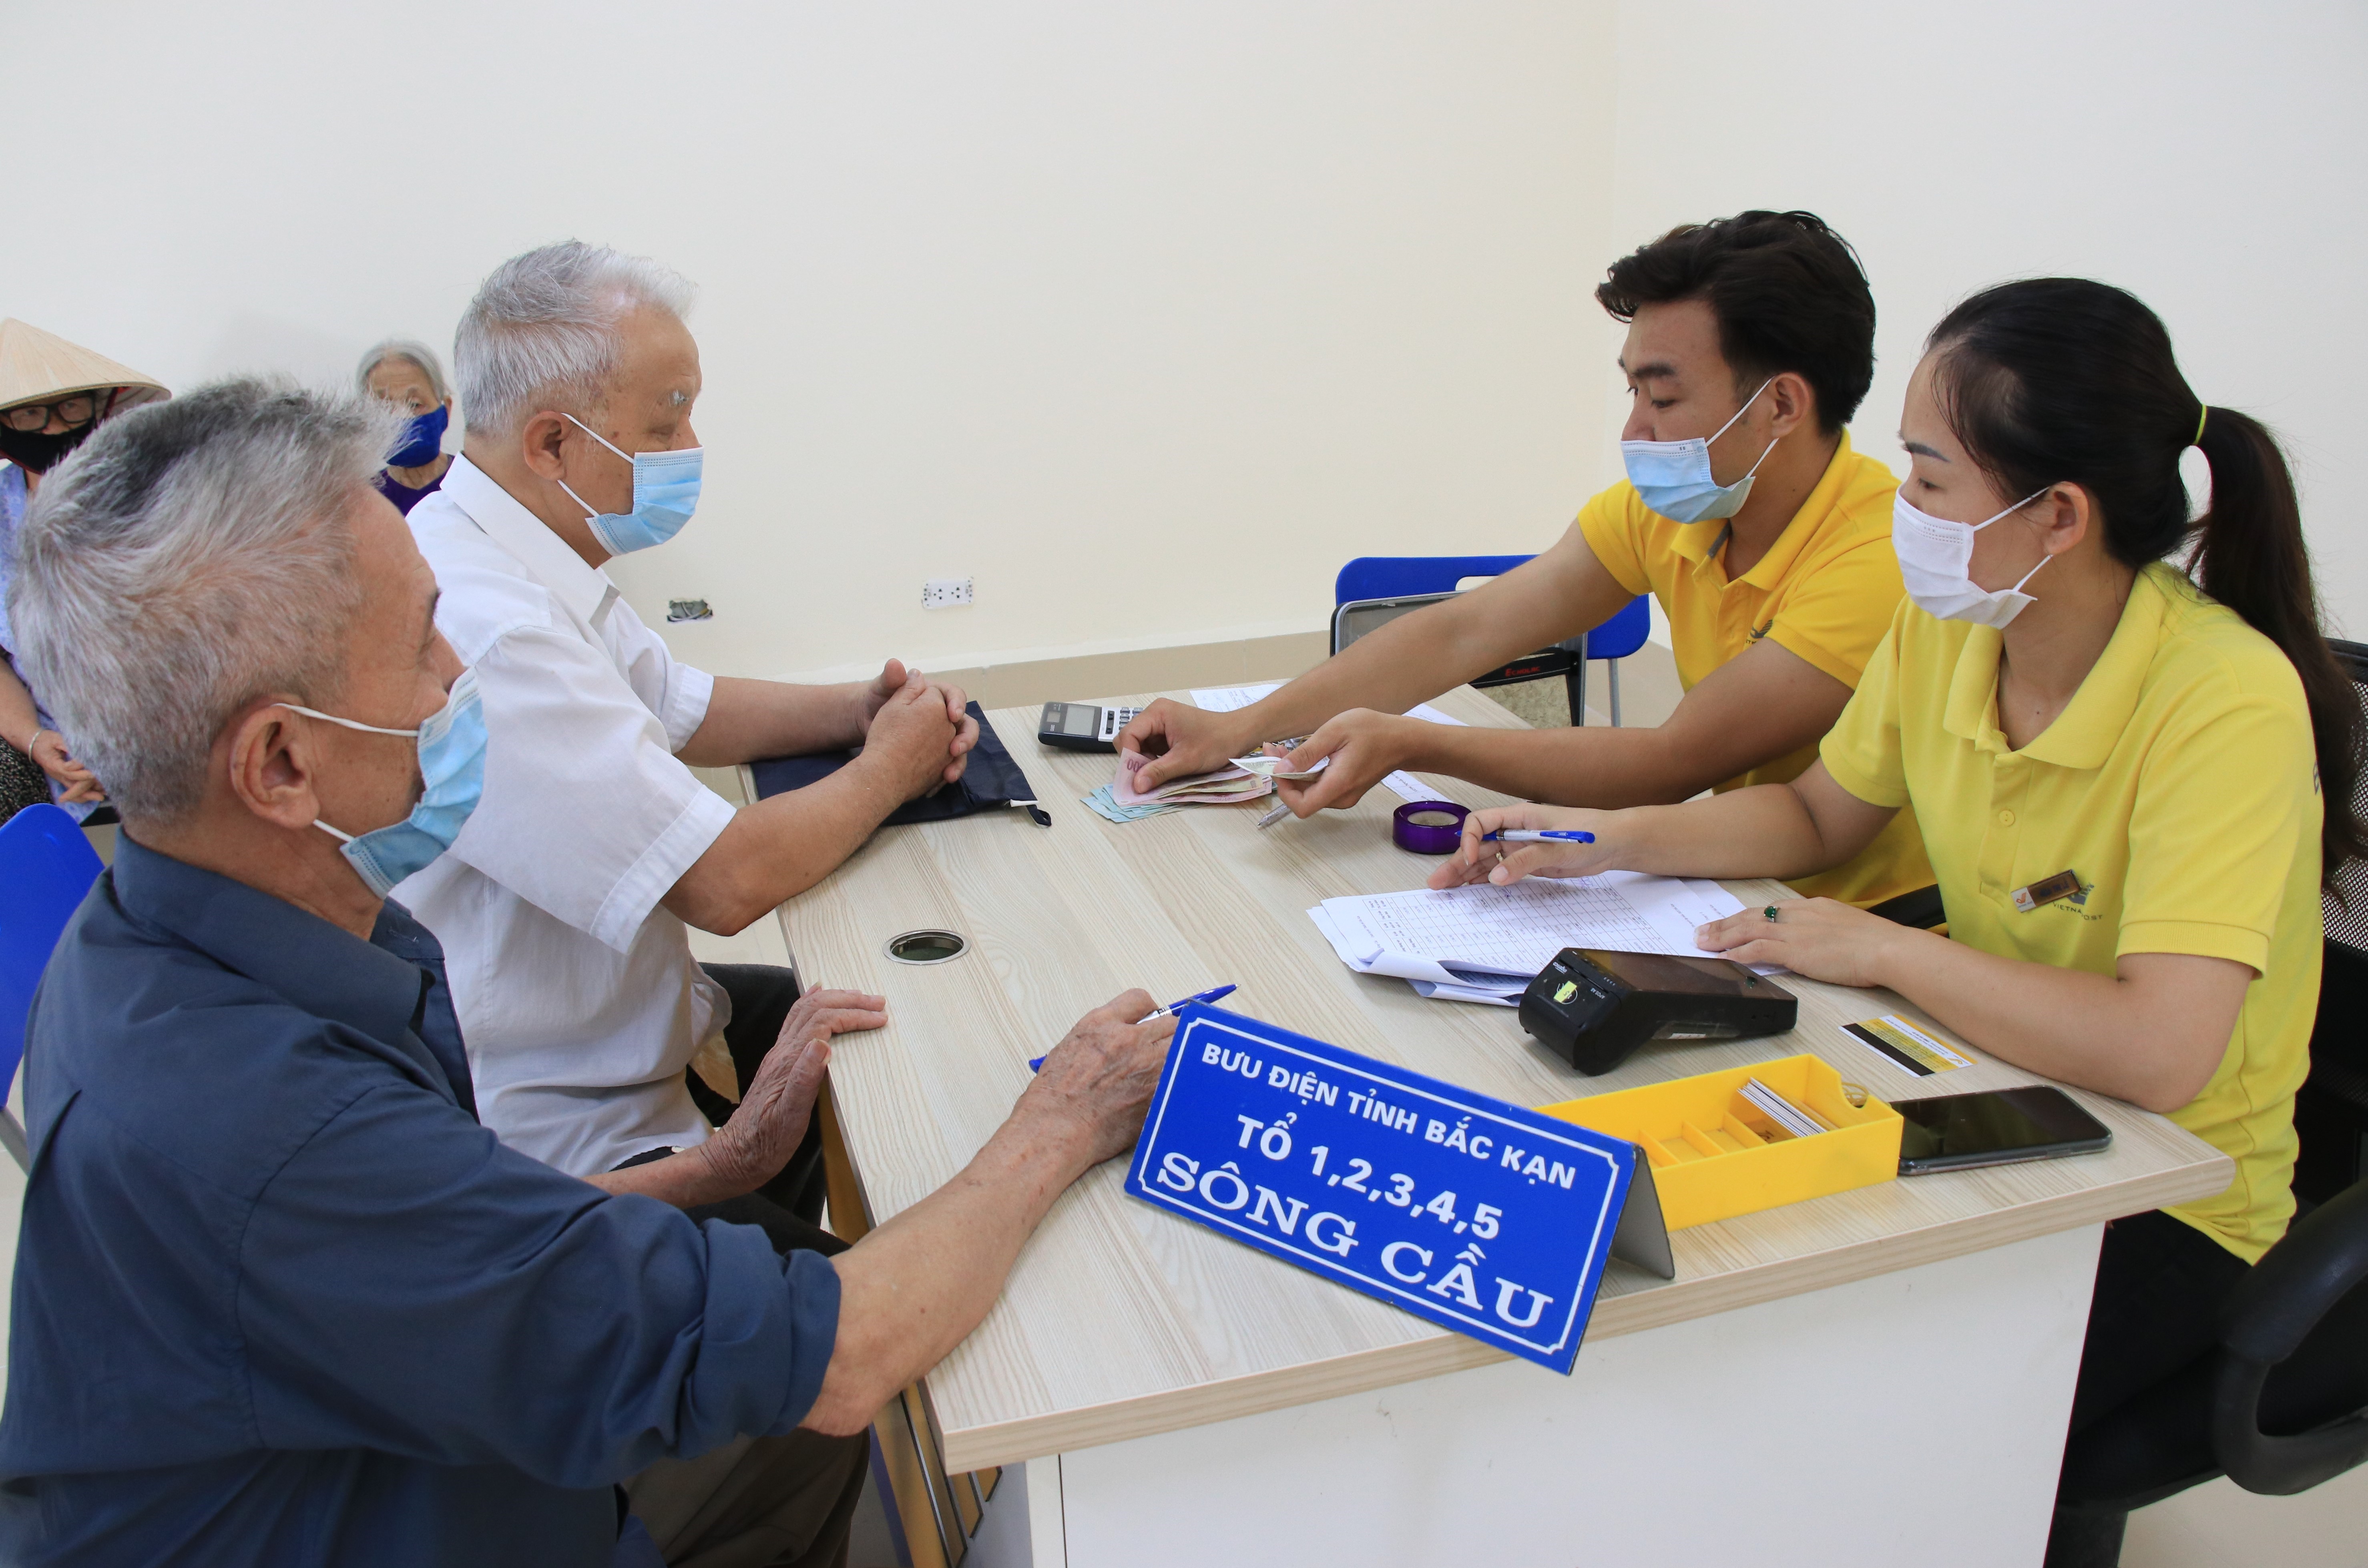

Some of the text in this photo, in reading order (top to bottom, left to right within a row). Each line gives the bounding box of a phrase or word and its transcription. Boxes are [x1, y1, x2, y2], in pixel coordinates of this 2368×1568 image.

[2053, 901, 2081, 913] VIETNA
[1202, 1043, 1576, 1189] BƯU ĐIỆN TỈNH BẮC KẠN
[1238, 1112, 1502, 1239] TỔ 1,2,3,4,5
[1157, 1152, 1554, 1327] SÔNG CẦU
